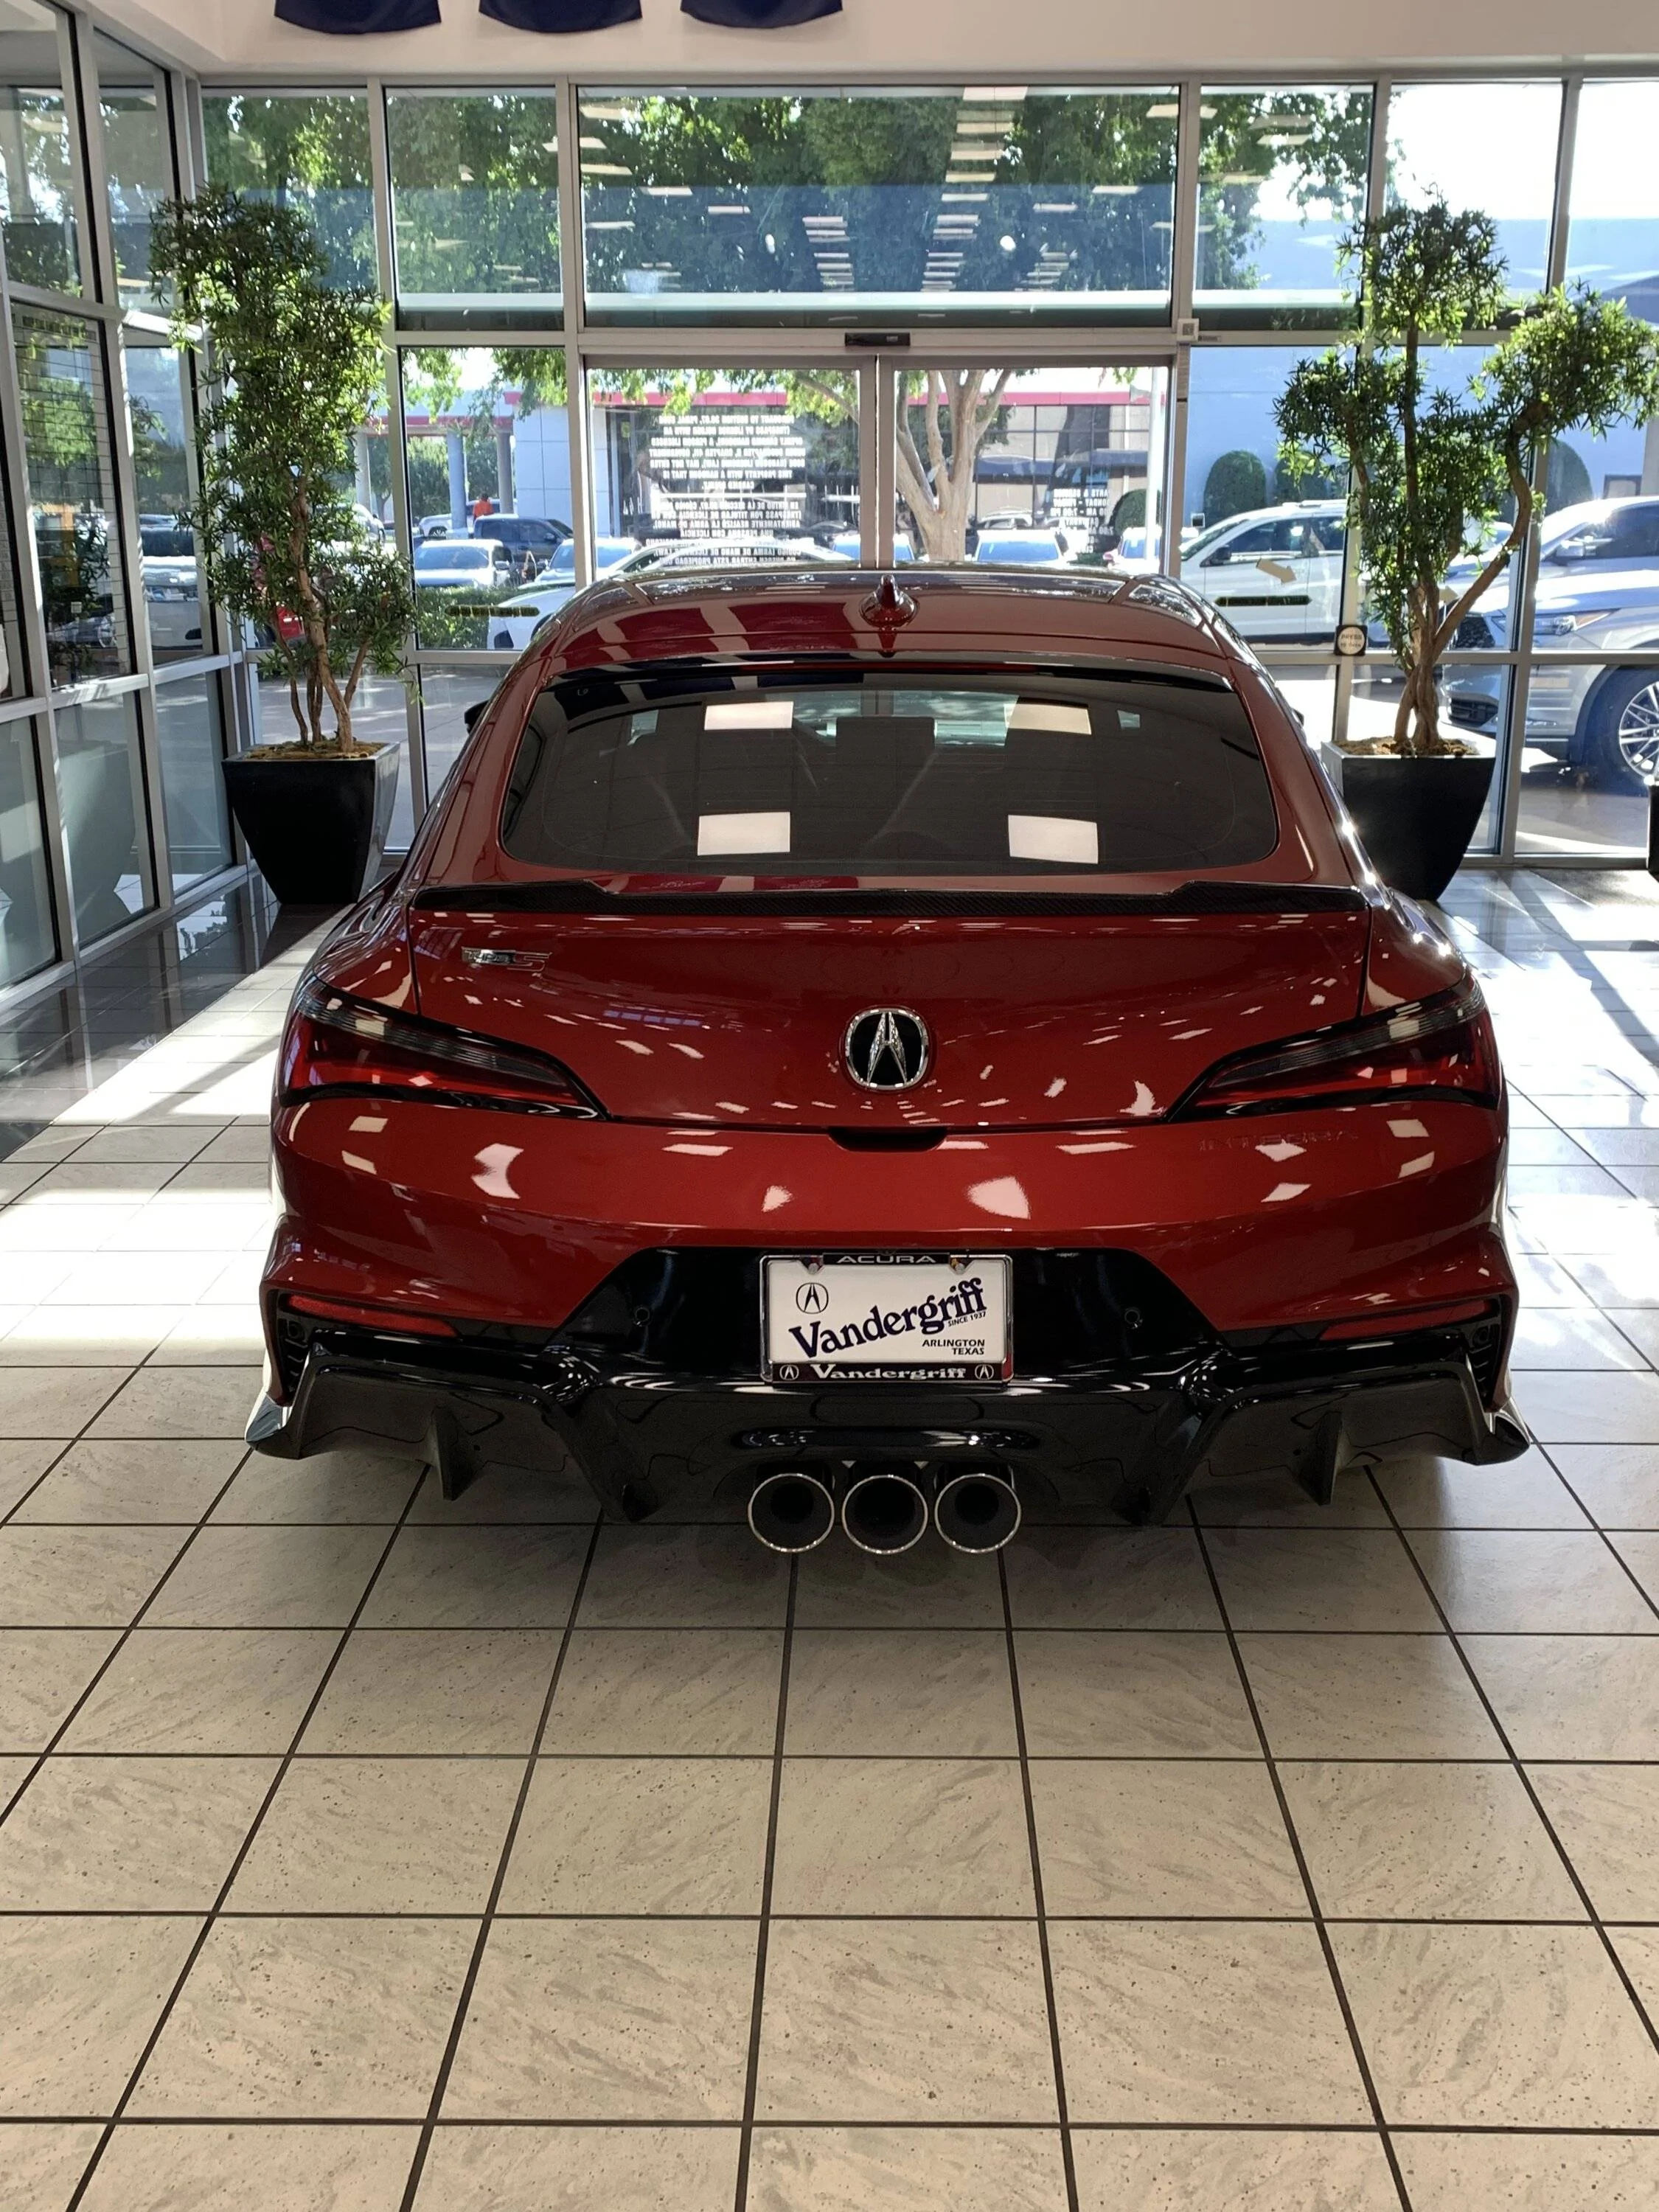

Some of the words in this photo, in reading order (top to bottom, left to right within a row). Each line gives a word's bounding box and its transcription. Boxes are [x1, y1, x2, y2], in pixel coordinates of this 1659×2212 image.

[836, 1255, 936, 1264] ACURA
[788, 1277, 987, 1358] Vandergriff
[948, 1317, 968, 1327] SINCE
[970, 1312, 987, 1322] 1937
[922, 1339, 985, 1348] ARLINGTON
[952, 1347, 985, 1355] TEXAS
[810, 1363, 967, 1380] Vandergriff
